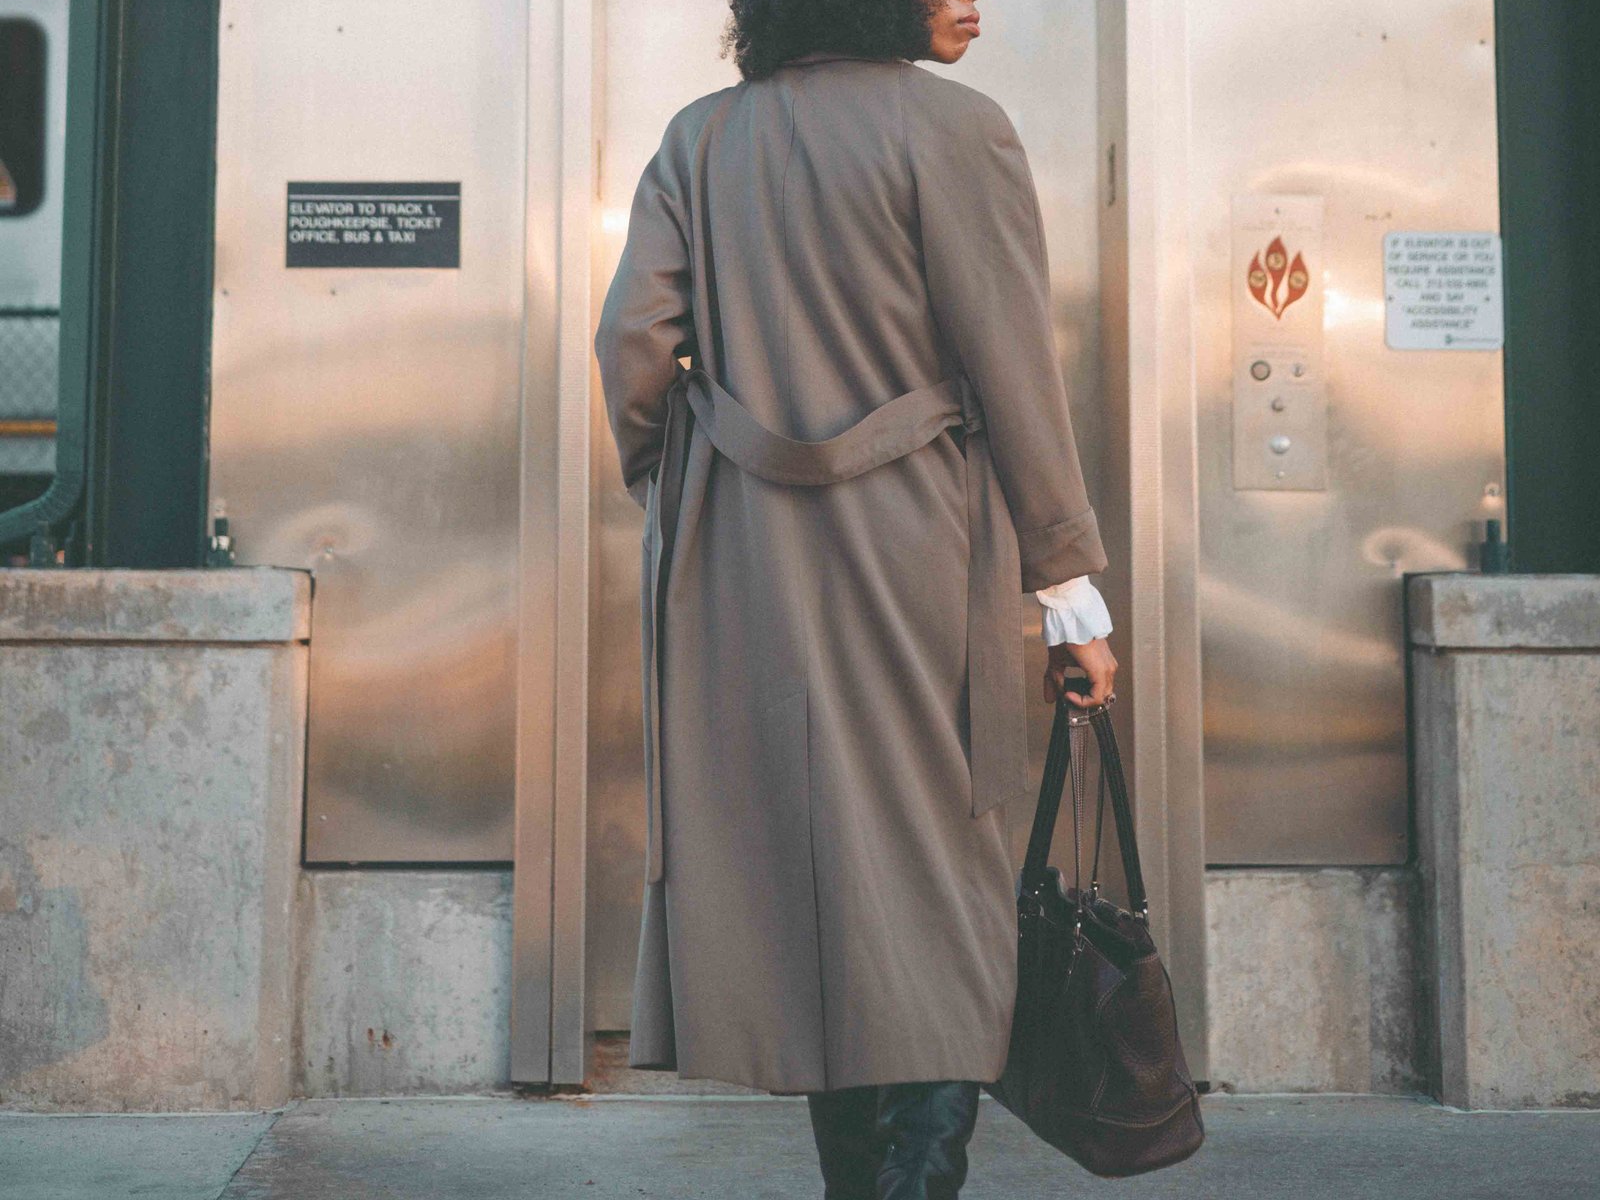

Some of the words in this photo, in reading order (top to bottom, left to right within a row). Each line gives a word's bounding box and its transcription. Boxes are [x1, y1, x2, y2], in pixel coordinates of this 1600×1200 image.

[289, 202, 354, 215] ELEVATOR
[357, 202, 376, 215] TO
[379, 202, 423, 215] TRACK
[396, 216, 443, 230] TICKET
[343, 230, 371, 244] BUS
[373, 230, 384, 244] &
[388, 230, 416, 244] TAXI
[1404, 238, 1455, 248] ELEVATOR
[1470, 238, 1492, 248] OUT
[1407, 251, 1449, 262] SERVICE
[1387, 265, 1431, 276] REQUIRE
[1436, 265, 1496, 276] ASSISTANCE
[1395, 279, 1421, 290] CALL
